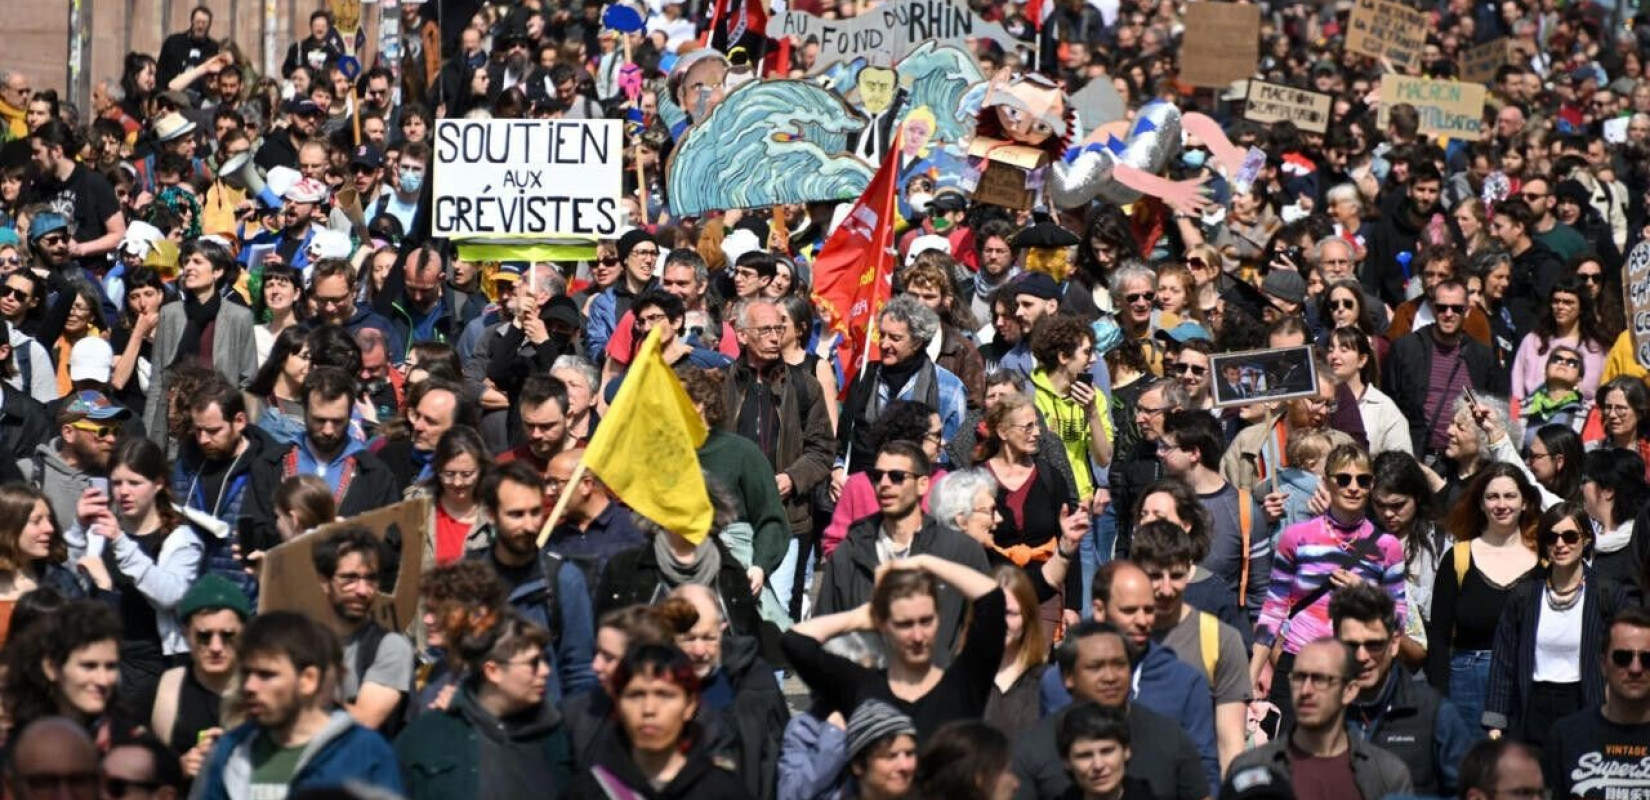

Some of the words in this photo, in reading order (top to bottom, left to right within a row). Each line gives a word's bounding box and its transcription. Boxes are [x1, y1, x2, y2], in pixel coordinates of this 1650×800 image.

[783, 14, 807, 35] AU
[821, 26, 883, 54] FOND
[883, 10, 909, 29] DU
[1396, 81, 1461, 101] MACRON
[503, 170, 543, 188] AUX
[1605, 745, 1648, 757] VINTAGE
